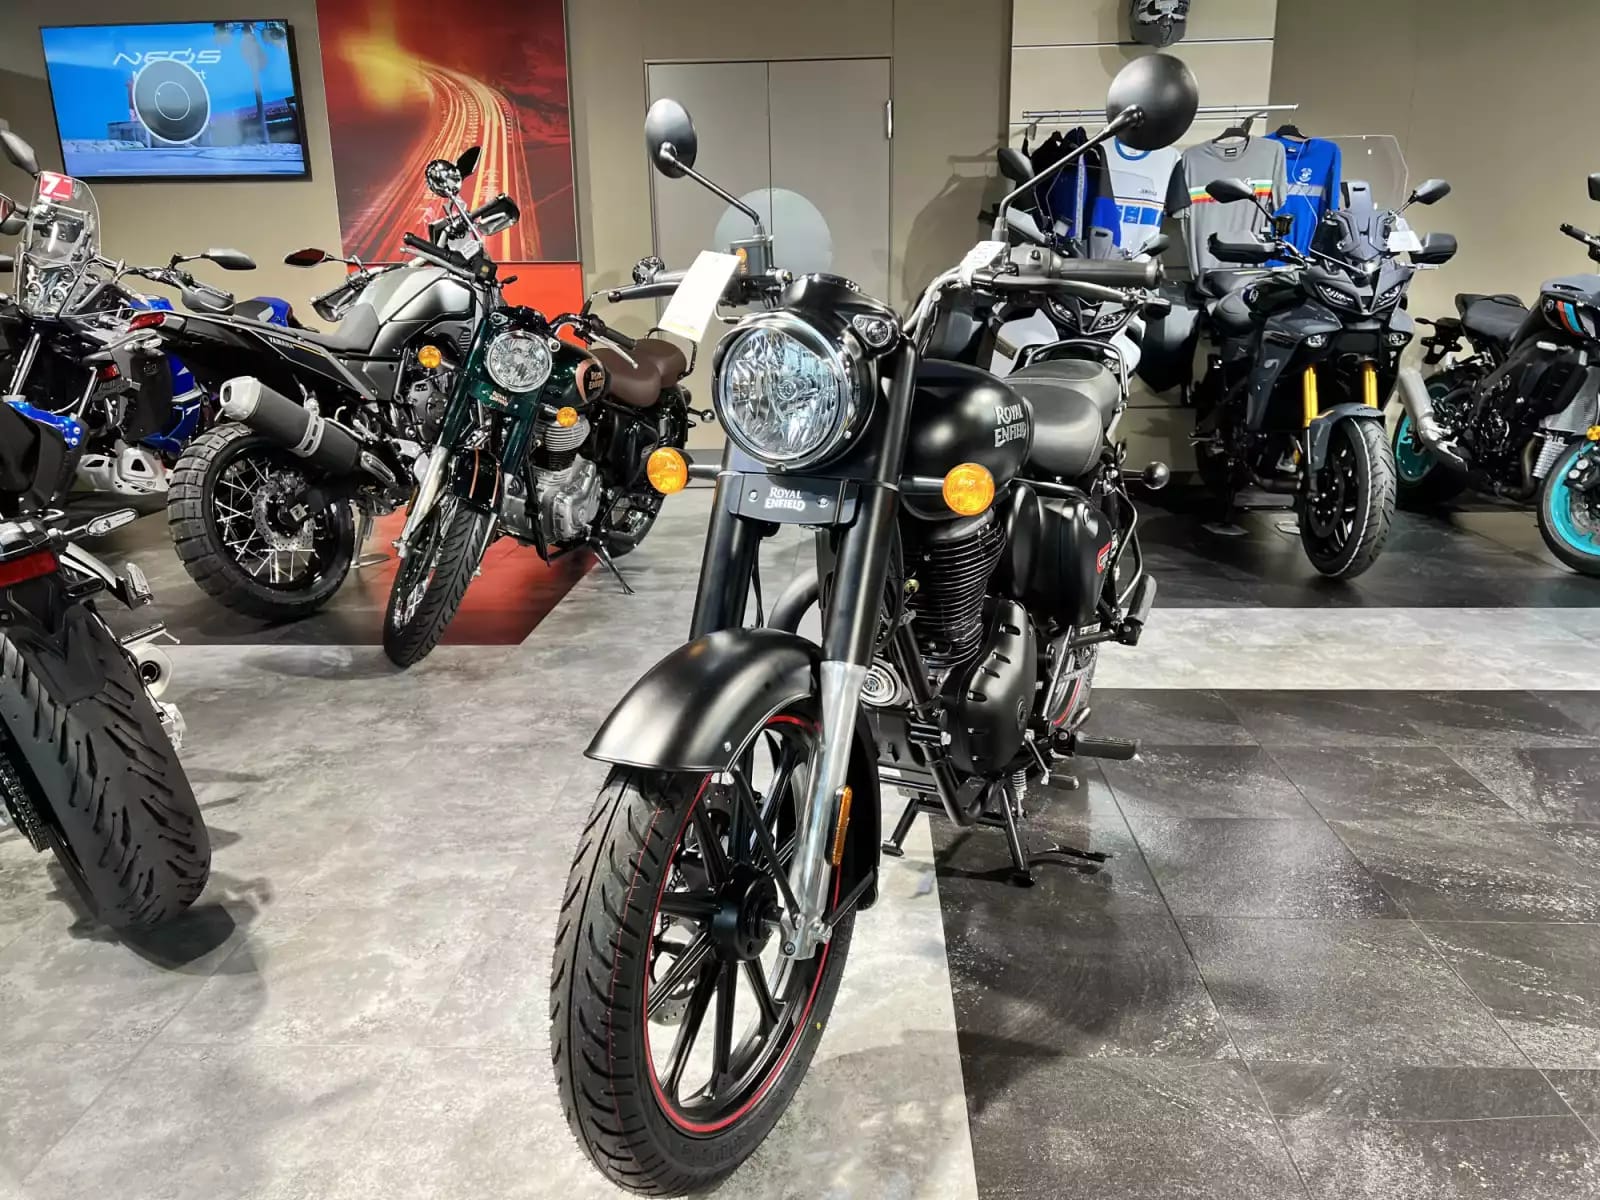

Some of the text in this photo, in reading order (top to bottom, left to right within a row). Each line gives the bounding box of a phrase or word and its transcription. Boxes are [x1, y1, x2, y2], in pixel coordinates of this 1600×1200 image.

[995, 403, 1023, 425] ROYAL
[994, 421, 1027, 448] ENFIELD
[769, 486, 803, 499] ROYAL
[764, 497, 806, 511] ENFIELD
